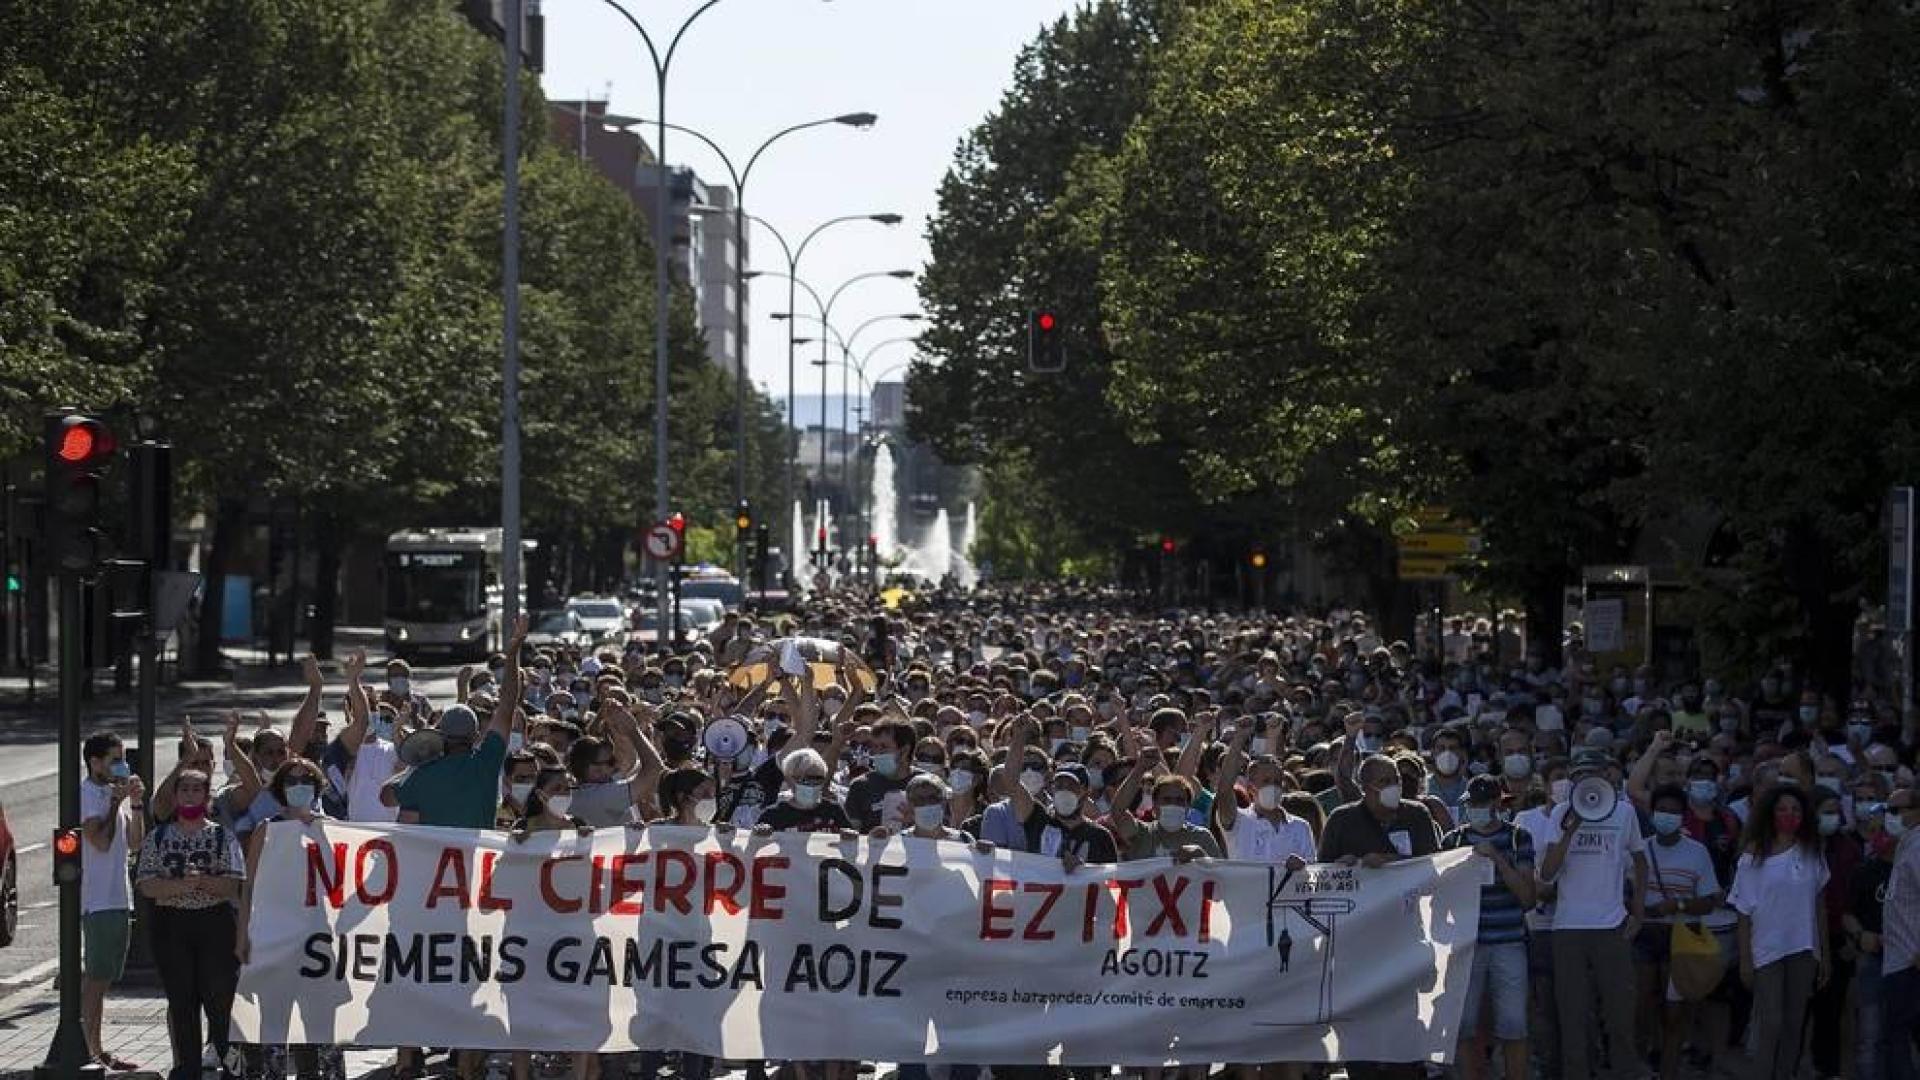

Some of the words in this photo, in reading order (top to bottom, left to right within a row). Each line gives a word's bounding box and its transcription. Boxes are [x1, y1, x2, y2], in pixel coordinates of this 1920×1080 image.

[304, 839, 398, 908] NO
[425, 847, 513, 912] AL
[539, 848, 790, 920] CIERRE
[818, 858, 909, 930] DE
[980, 879, 1064, 940] EZ
[1082, 873, 1216, 944] ITXI
[299, 932, 528, 984] SIEMENS
[546, 935, 764, 991] GAMESA
[784, 942, 908, 997] AOIZ
[1101, 948, 1209, 978] AGOITZ
[946, 987, 1007, 1004] enpresa
[1158, 992, 1175, 1007] de
[1179, 997, 1245, 1010] empresa
